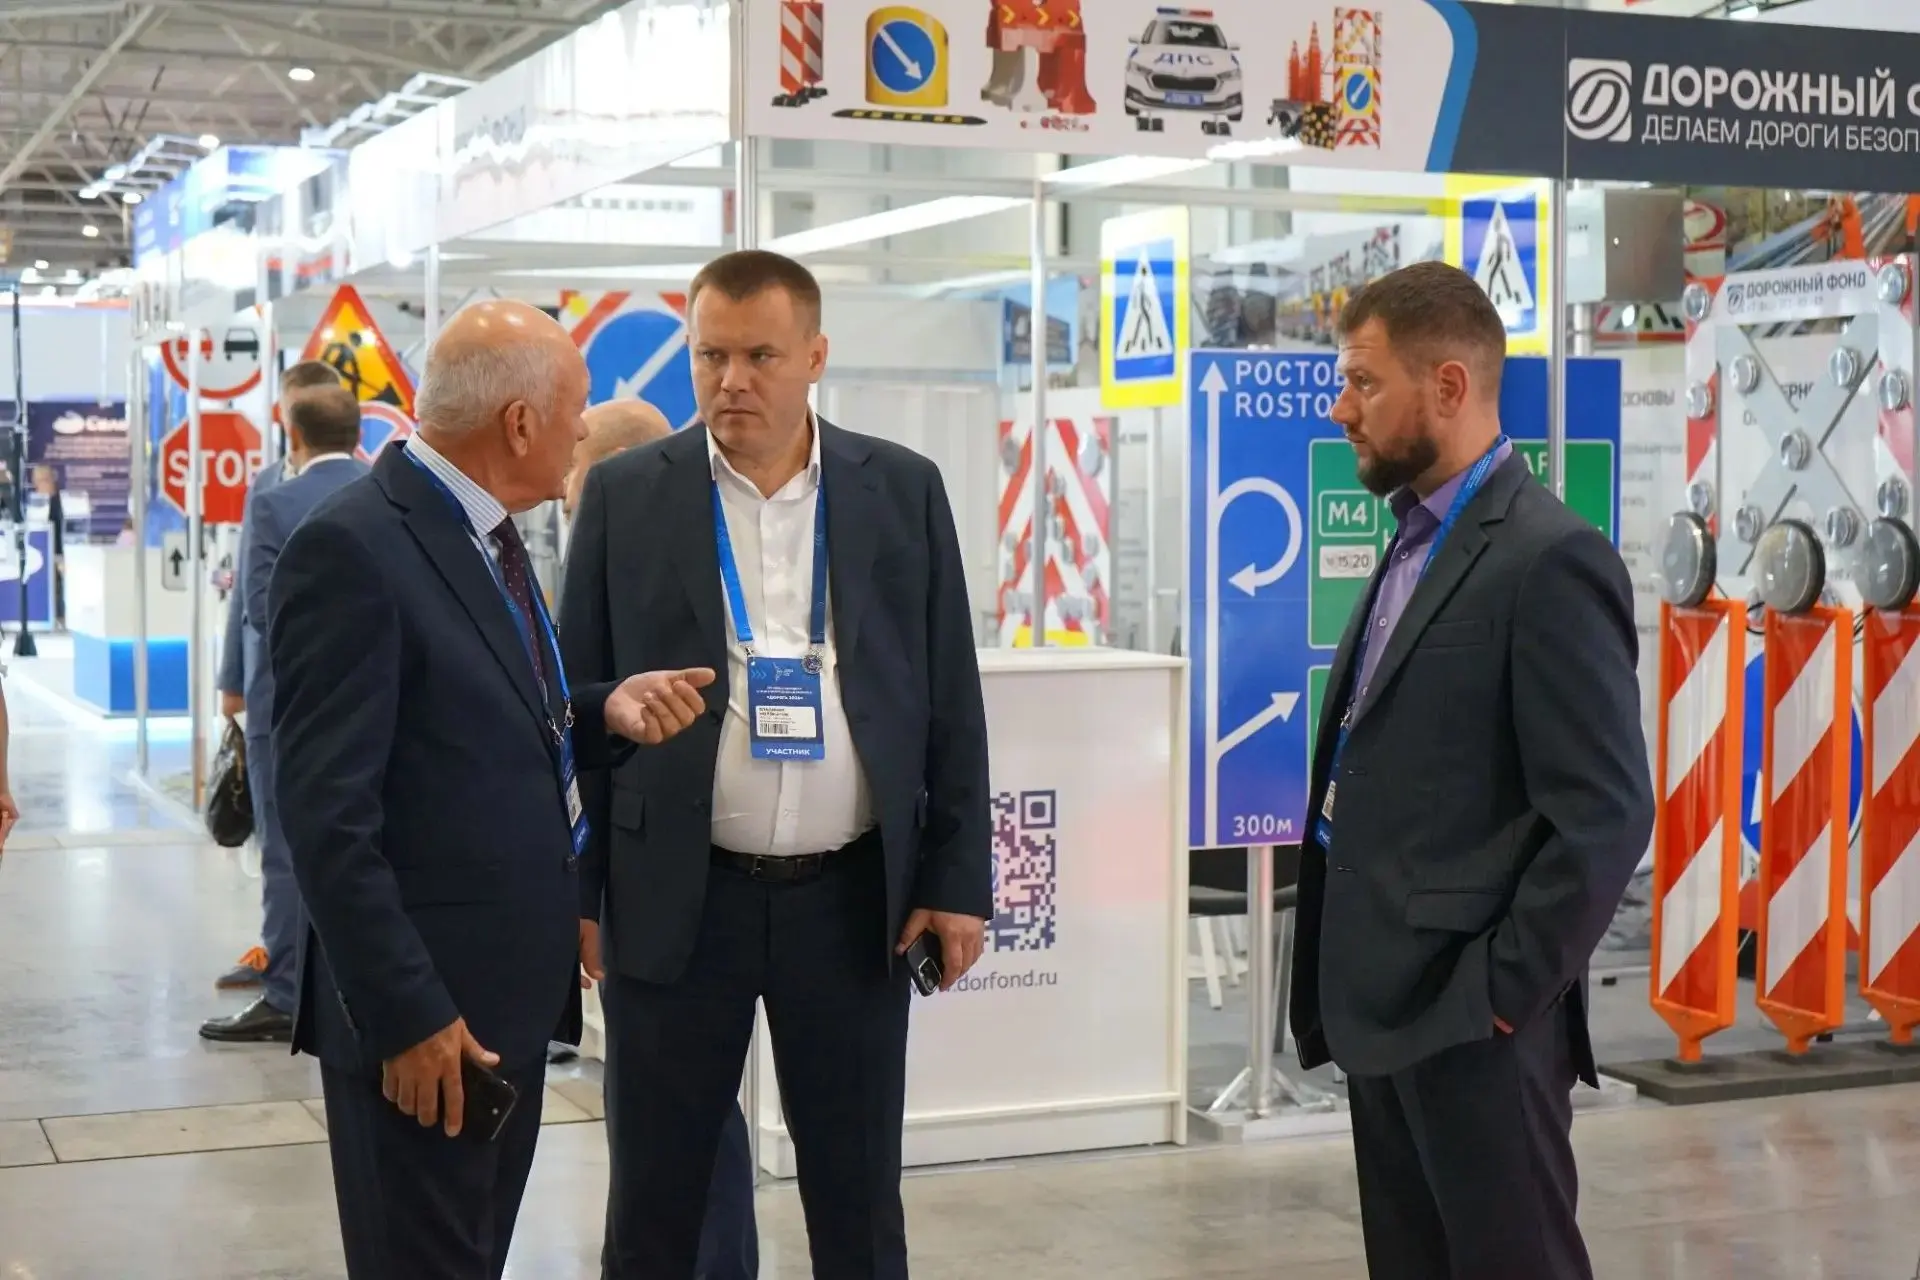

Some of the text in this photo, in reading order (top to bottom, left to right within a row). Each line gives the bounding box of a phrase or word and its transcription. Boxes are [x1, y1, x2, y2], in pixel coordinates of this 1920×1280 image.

[1153, 53, 1214, 66] ДПС
[1642, 63, 1896, 119] ДОРОЖНЫЙ
[1641, 114, 1920, 152] ДЕЛАЕМ ДОРОГИ БЕЗОП
[1746, 271, 1866, 298] ДОРОЖНЫЙ ФОНД
[1235, 391, 1339, 418] ROSTO
[766, 748, 811, 756] УЧАСТНИК
[910, 969, 1058, 995] .dorfond.ru
